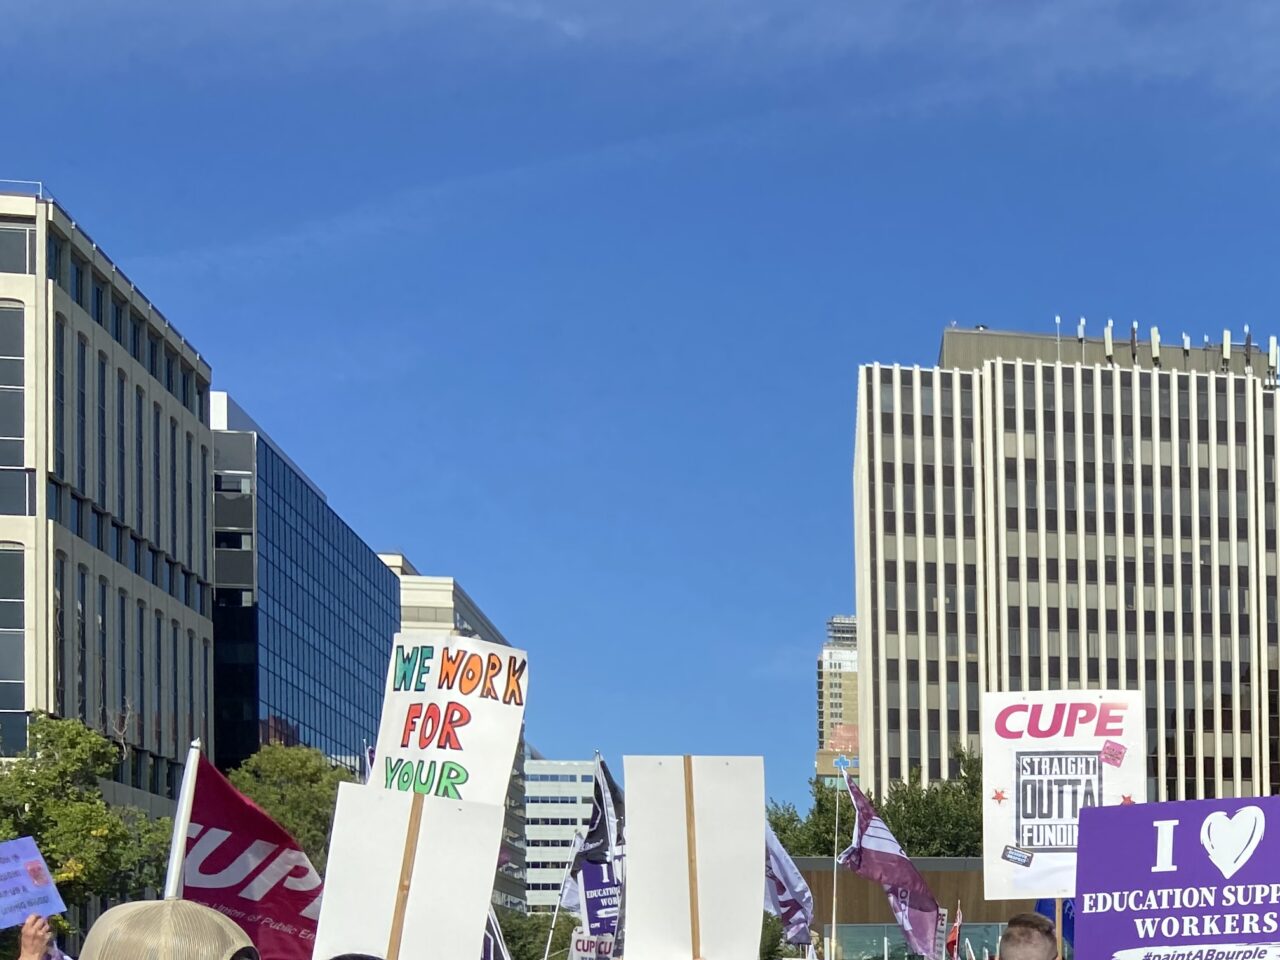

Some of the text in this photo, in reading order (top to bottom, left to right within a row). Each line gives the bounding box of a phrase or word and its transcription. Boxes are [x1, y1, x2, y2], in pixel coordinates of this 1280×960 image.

[393, 645, 527, 706] WE WORK
[400, 701, 472, 751] FOR
[994, 703, 1129, 739] CUPE
[384, 757, 469, 800] YOUR
[1021, 757, 1097, 776] STRAIGHT
[1021, 779, 1096, 819] OUTTA
[1021, 824, 1079, 847] FUNDI
[1150, 820, 1179, 872] I
[1082, 886, 1217, 913] EDUCATION
[261, 918, 297, 935] Public
[1134, 912, 1278, 938] WORKERS
